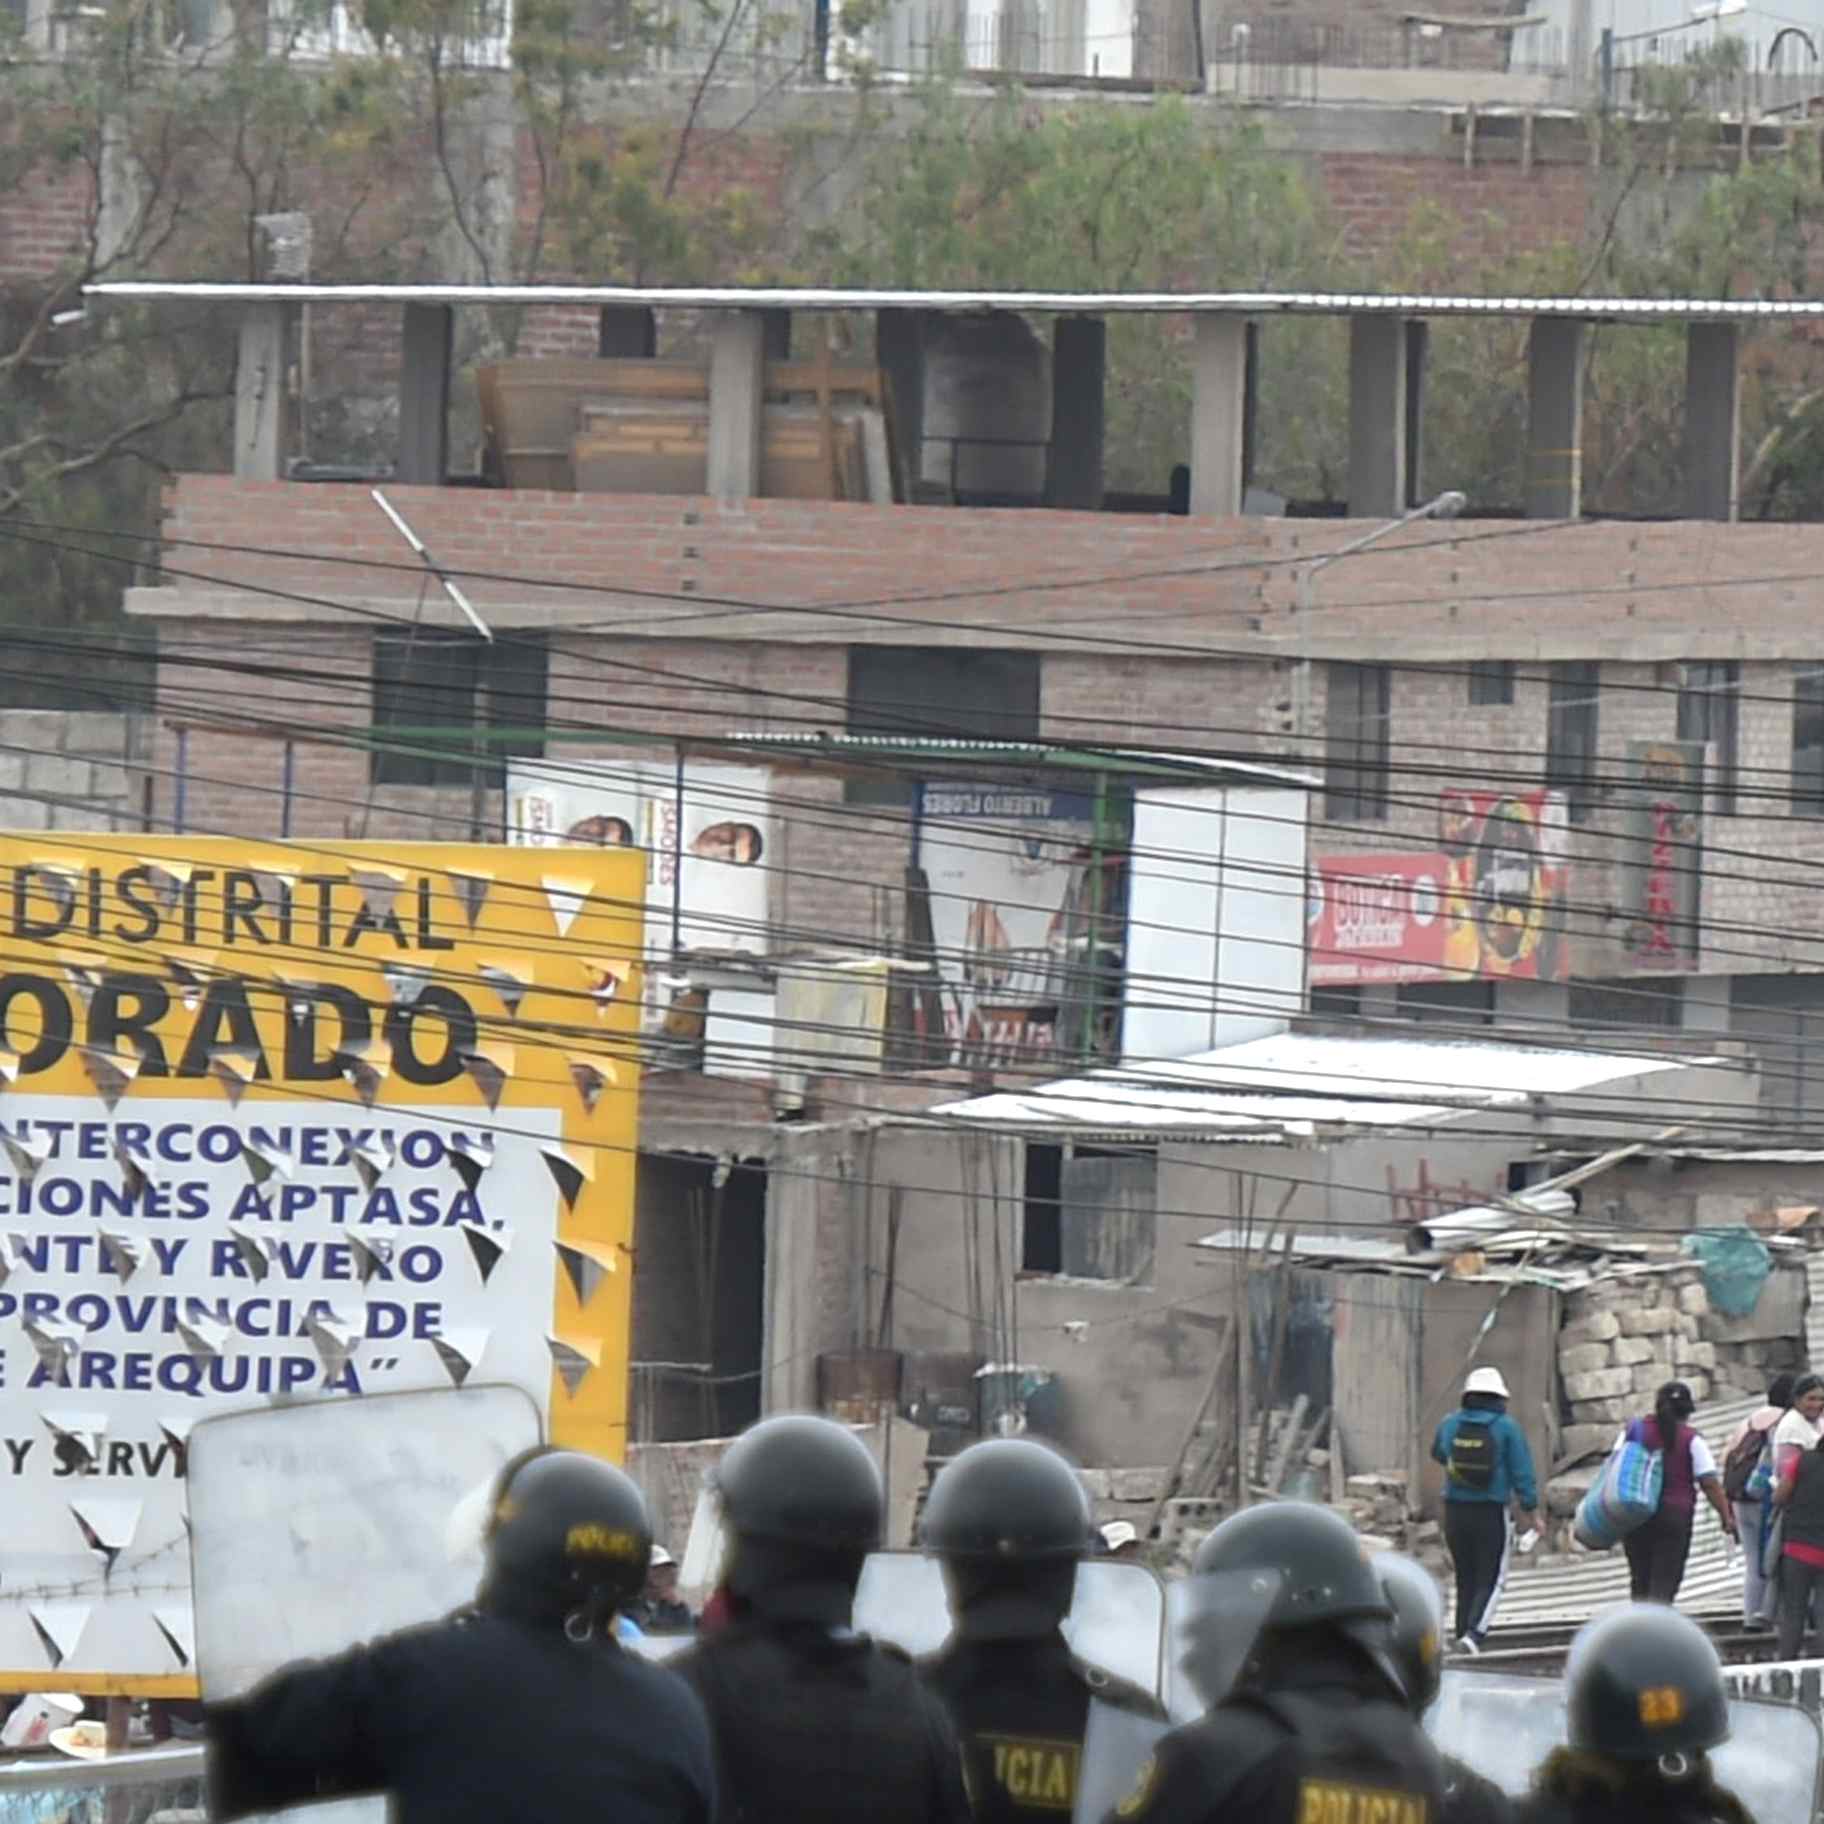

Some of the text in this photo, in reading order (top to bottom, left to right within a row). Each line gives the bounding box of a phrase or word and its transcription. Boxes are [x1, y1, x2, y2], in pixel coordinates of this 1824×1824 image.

[13, 866, 455, 951] DISTRITAL
[148, 1238, 189, 1276] Y
[366, 1302, 443, 1341] DE
[5, 1439, 34, 1477] Y
